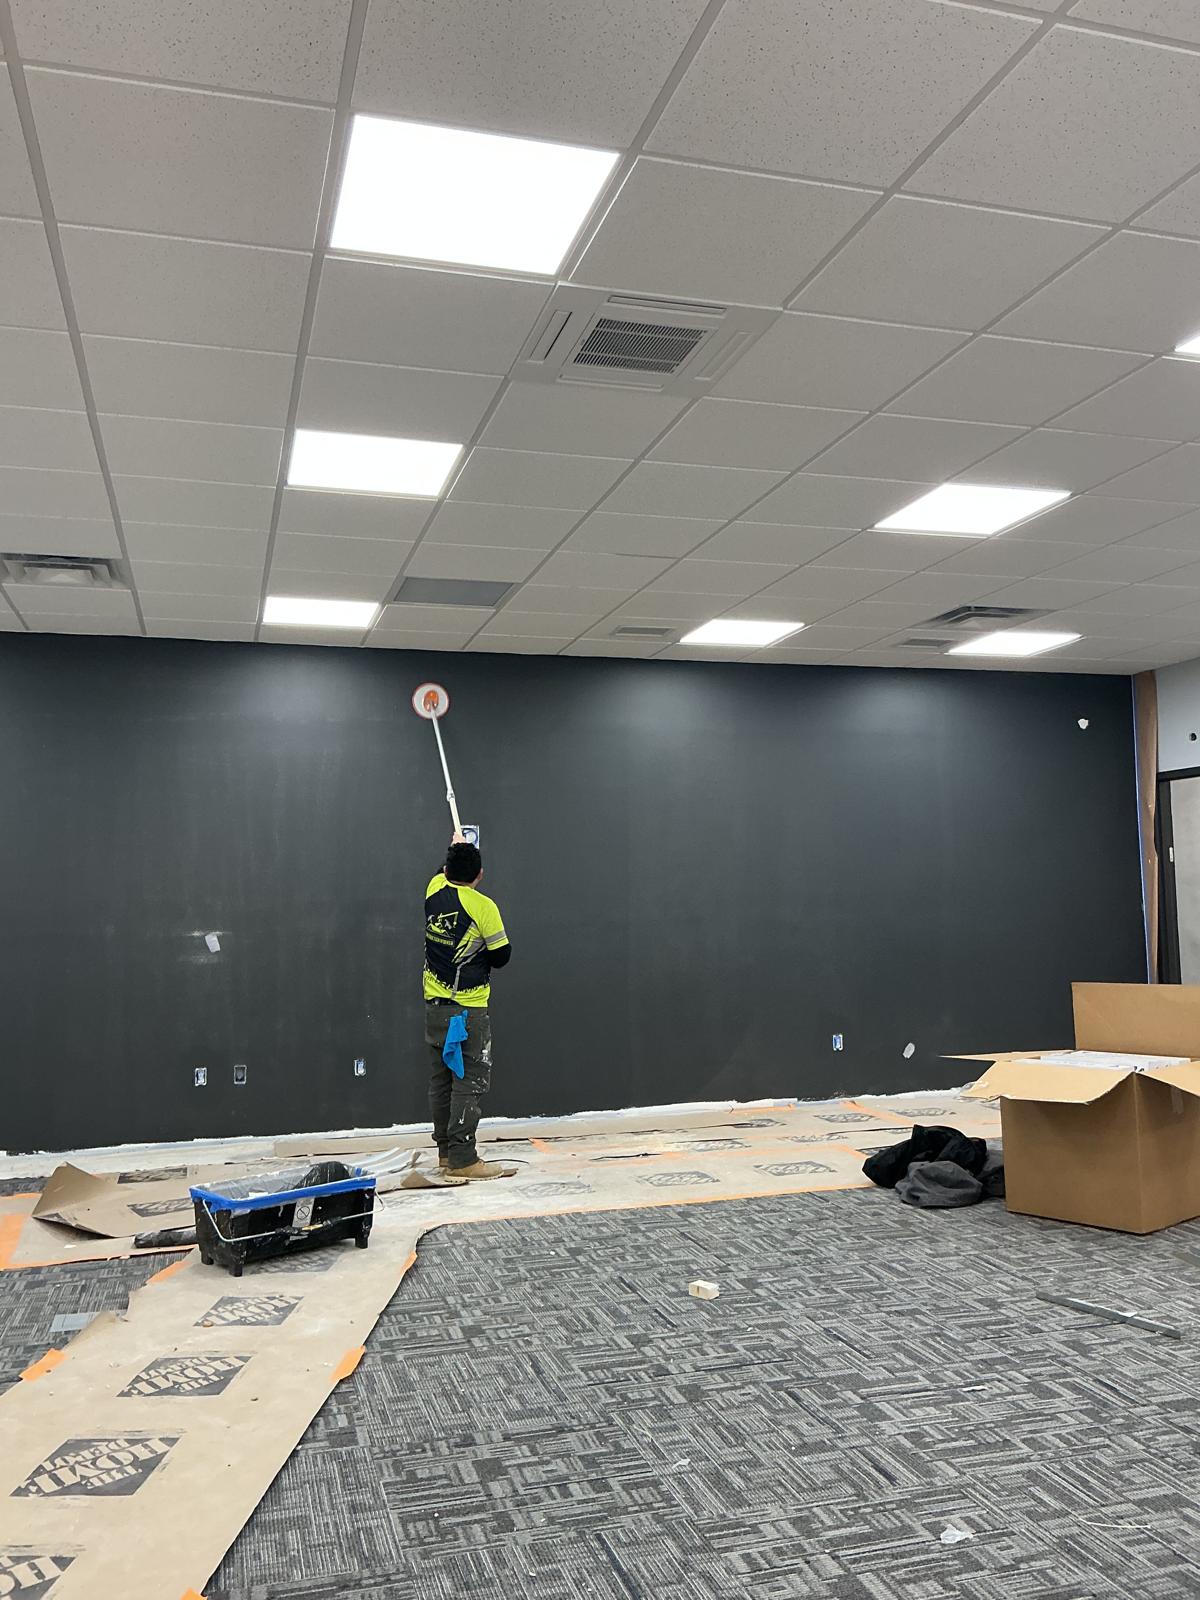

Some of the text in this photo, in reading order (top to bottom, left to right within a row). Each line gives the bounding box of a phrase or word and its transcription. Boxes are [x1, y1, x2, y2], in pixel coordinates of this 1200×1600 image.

[122, 1357, 247, 1397] HOME
[174, 1374, 224, 1393] THE
[20, 1438, 171, 1497] HOME
[40, 1438, 130, 1473] DEPOT
[81, 1465, 143, 1489] THE
